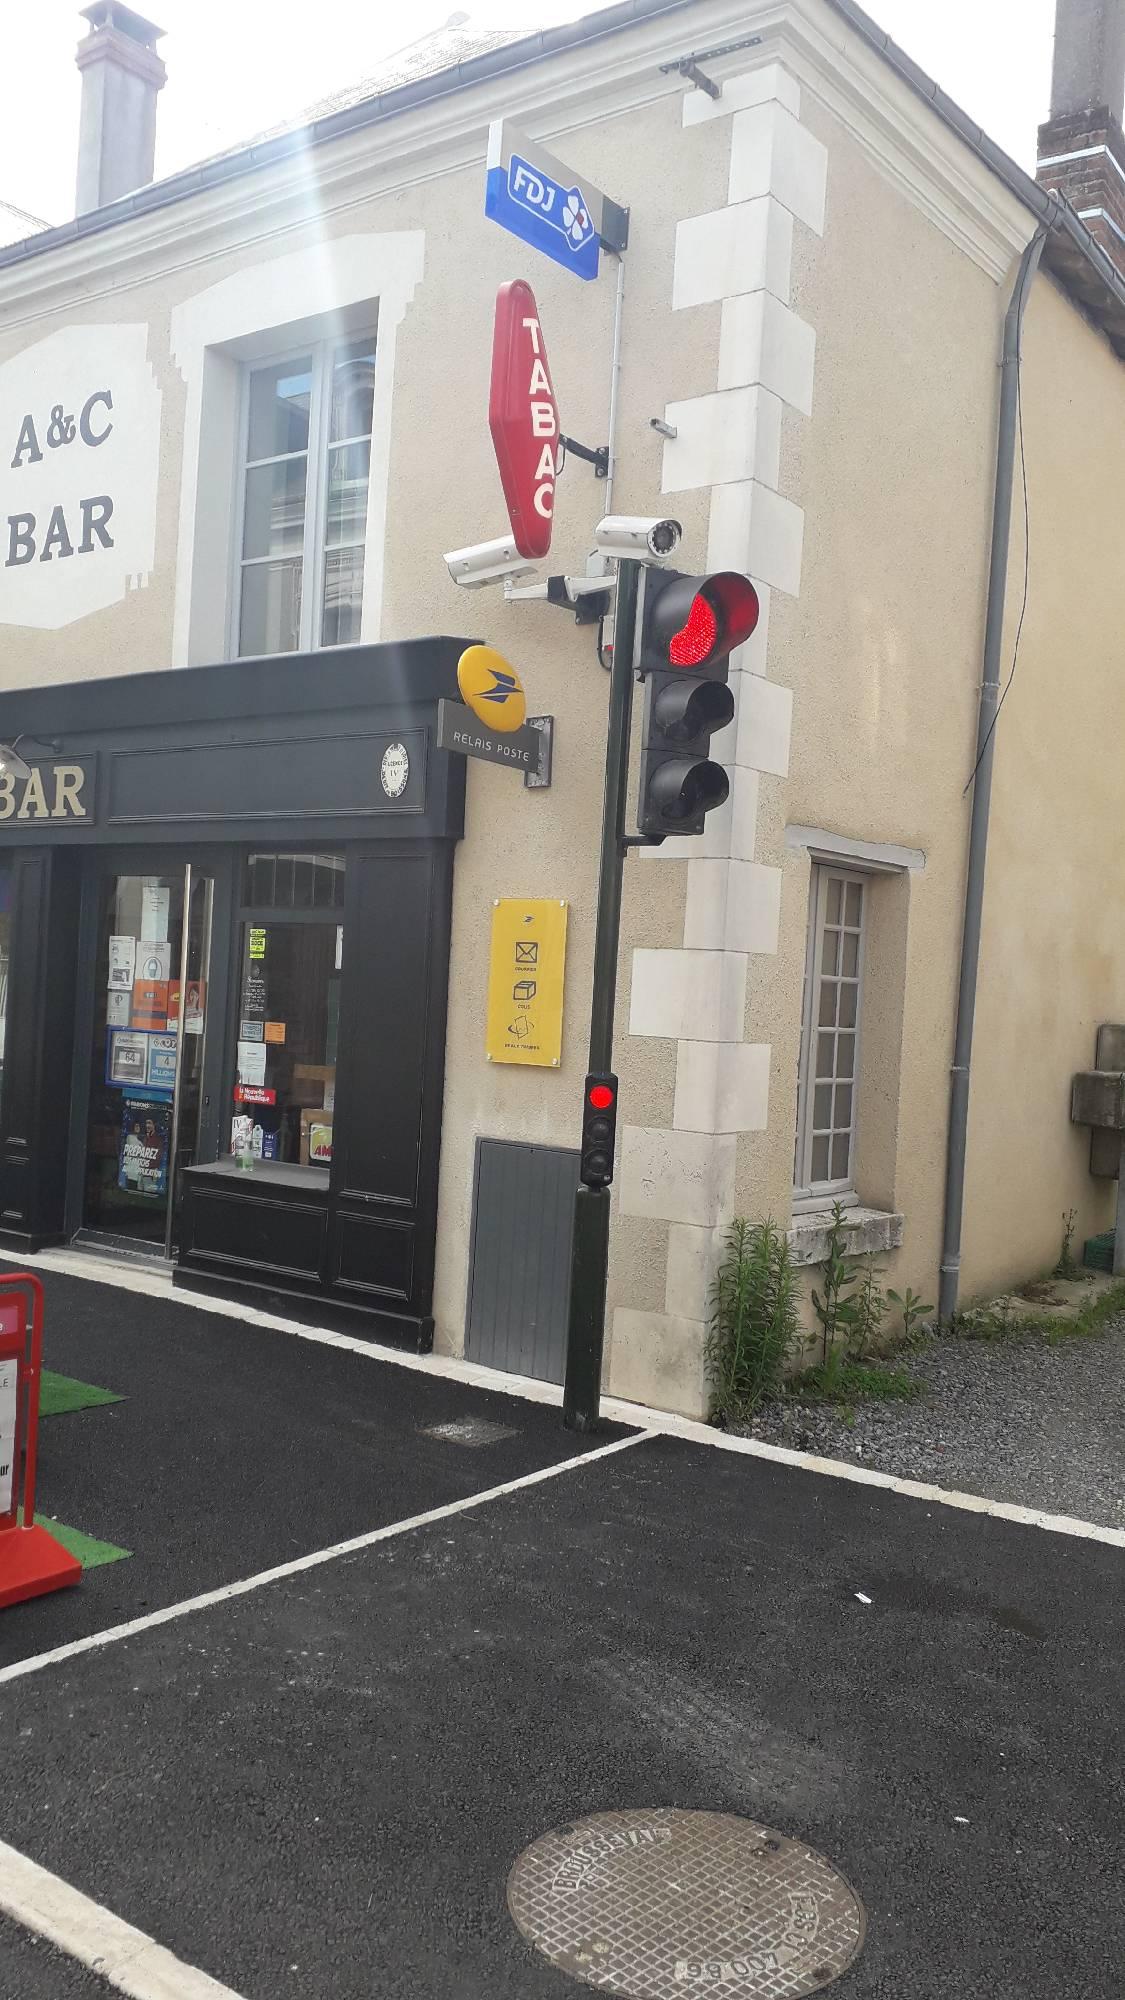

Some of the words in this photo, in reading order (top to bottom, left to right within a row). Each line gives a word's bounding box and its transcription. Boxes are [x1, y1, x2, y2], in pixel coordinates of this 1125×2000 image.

[514, 165, 556, 212] FDJ
[11, 390, 113, 468] A&C
[523, 317, 557, 519] TABAC
[5, 495, 114, 567] BAR
[453, 731, 492, 751] RELAIS
[497, 744, 529, 762] POSTE
[0, 765, 86, 819] BAR
